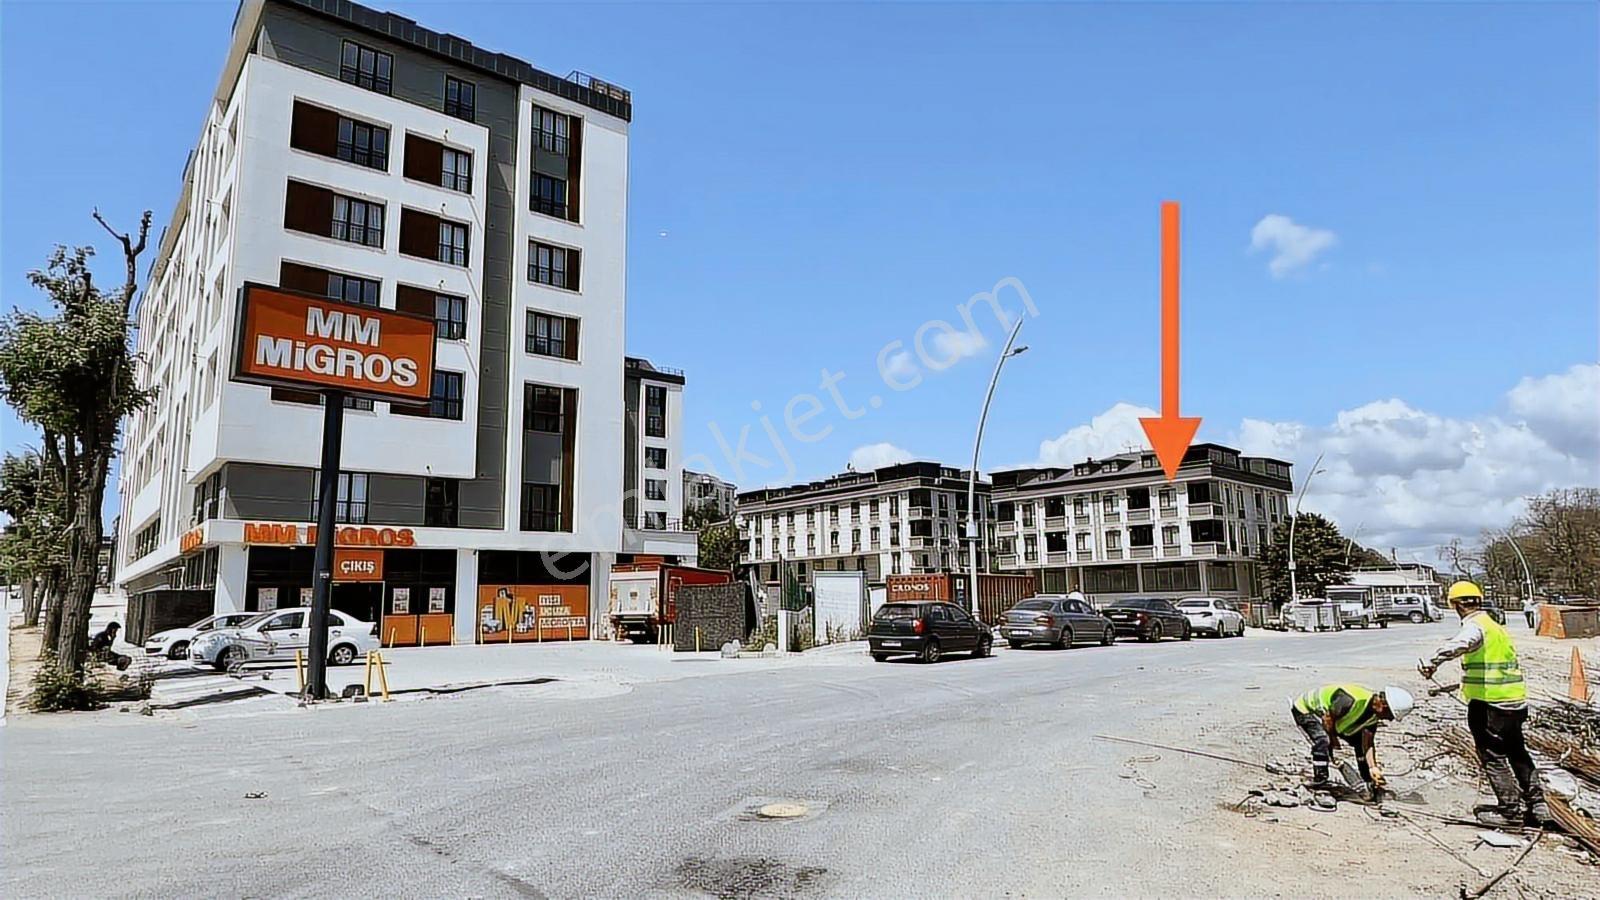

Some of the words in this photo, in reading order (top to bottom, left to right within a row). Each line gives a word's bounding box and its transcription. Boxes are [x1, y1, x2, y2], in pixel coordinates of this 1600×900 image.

[306, 306, 381, 347] MM
[255, 334, 418, 388] MiGROS
[244, 523, 297, 544] MM
